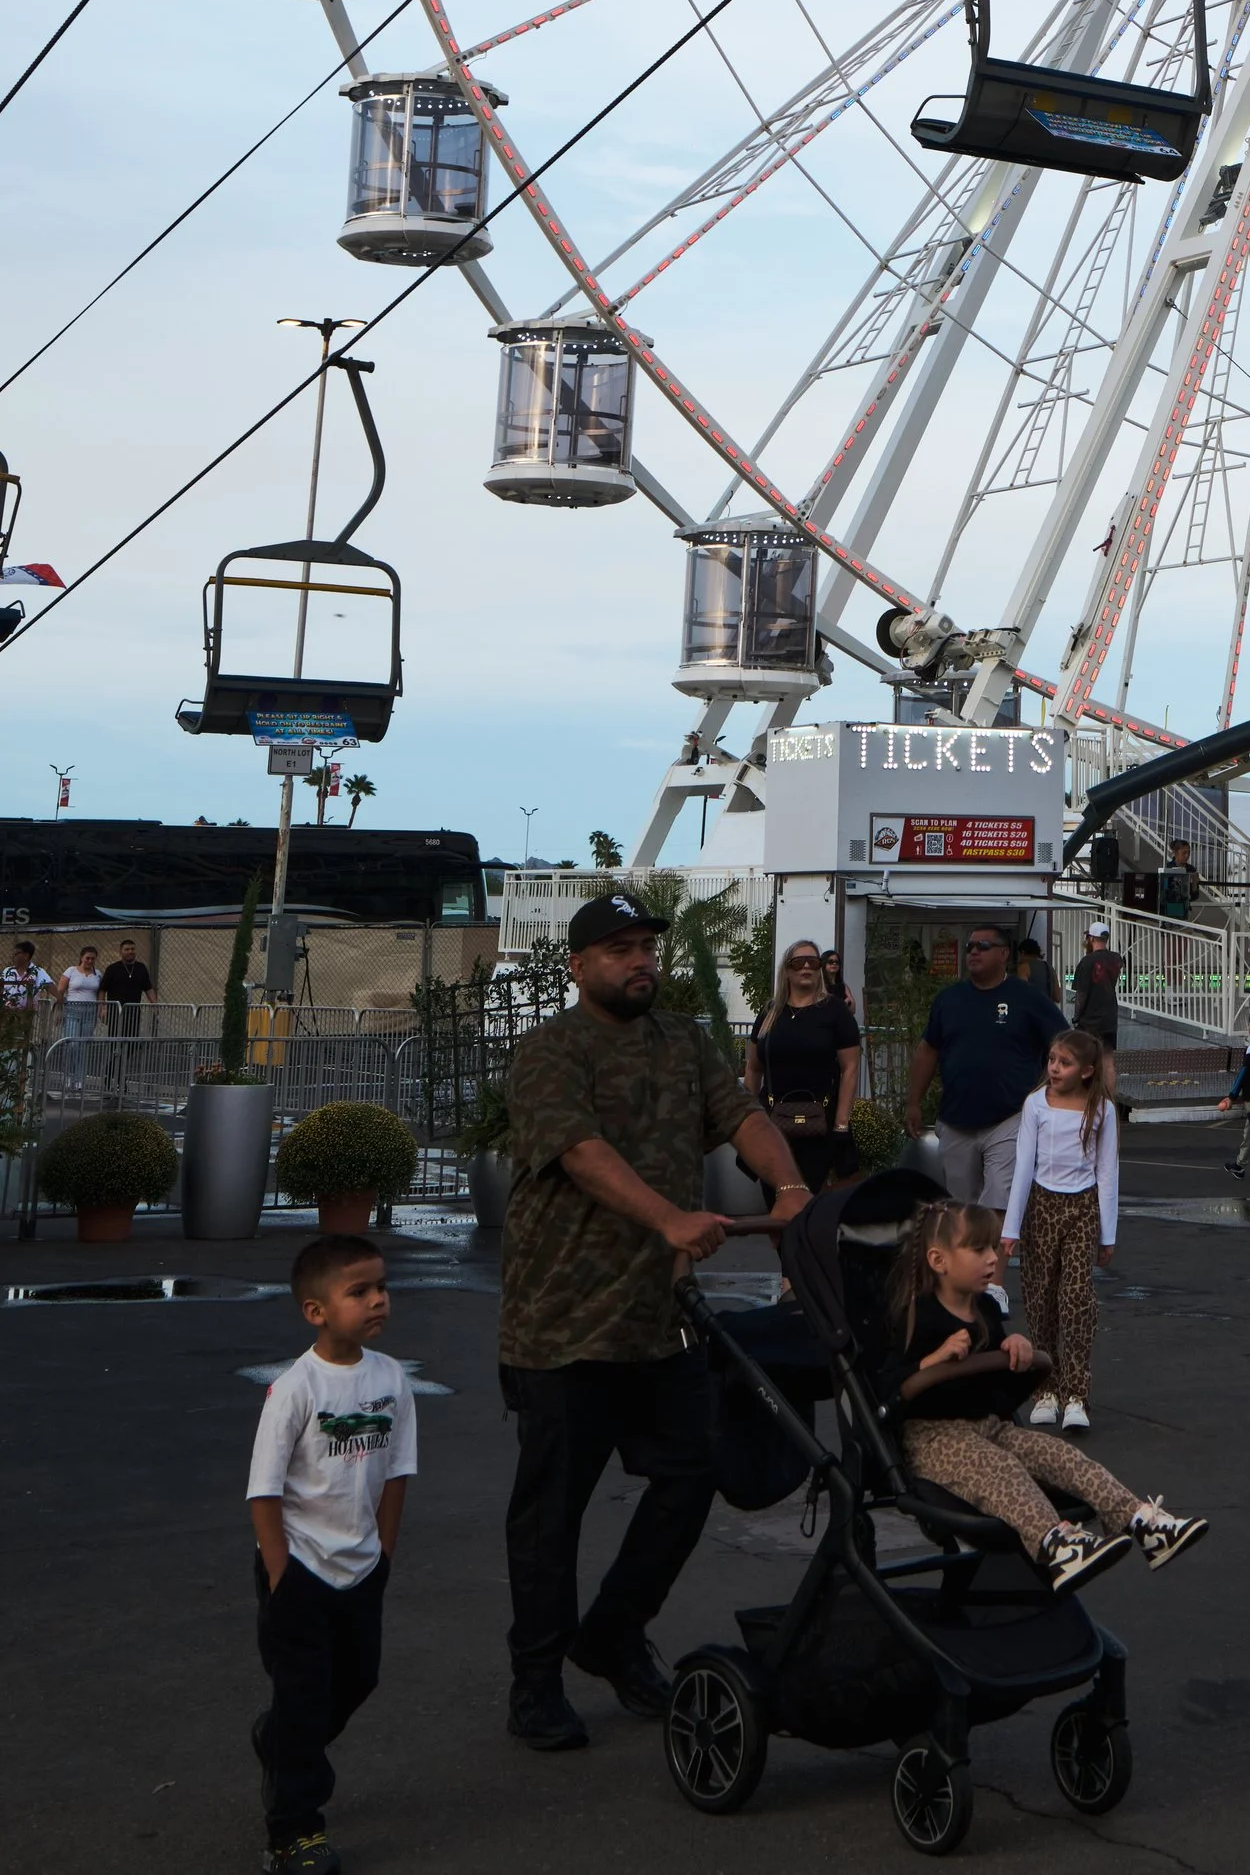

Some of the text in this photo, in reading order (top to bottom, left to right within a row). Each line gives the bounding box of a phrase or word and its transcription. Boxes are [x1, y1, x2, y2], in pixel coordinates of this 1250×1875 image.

[1159, 146, 1178, 156] 64
[342, 738, 357, 746] 63
[769, 734, 835, 762] TICKETS
[852, 726, 1055, 774] TICKETS
[273, 748, 311, 757] NORTH LOT
[286, 760, 297, 768] E1
[974, 821, 1009, 829] TICKETS
[973, 830, 1008, 838] TICKETS
[973, 839, 1009, 847] TICKETS
[962, 848, 1025, 856] FASTPASS $30
